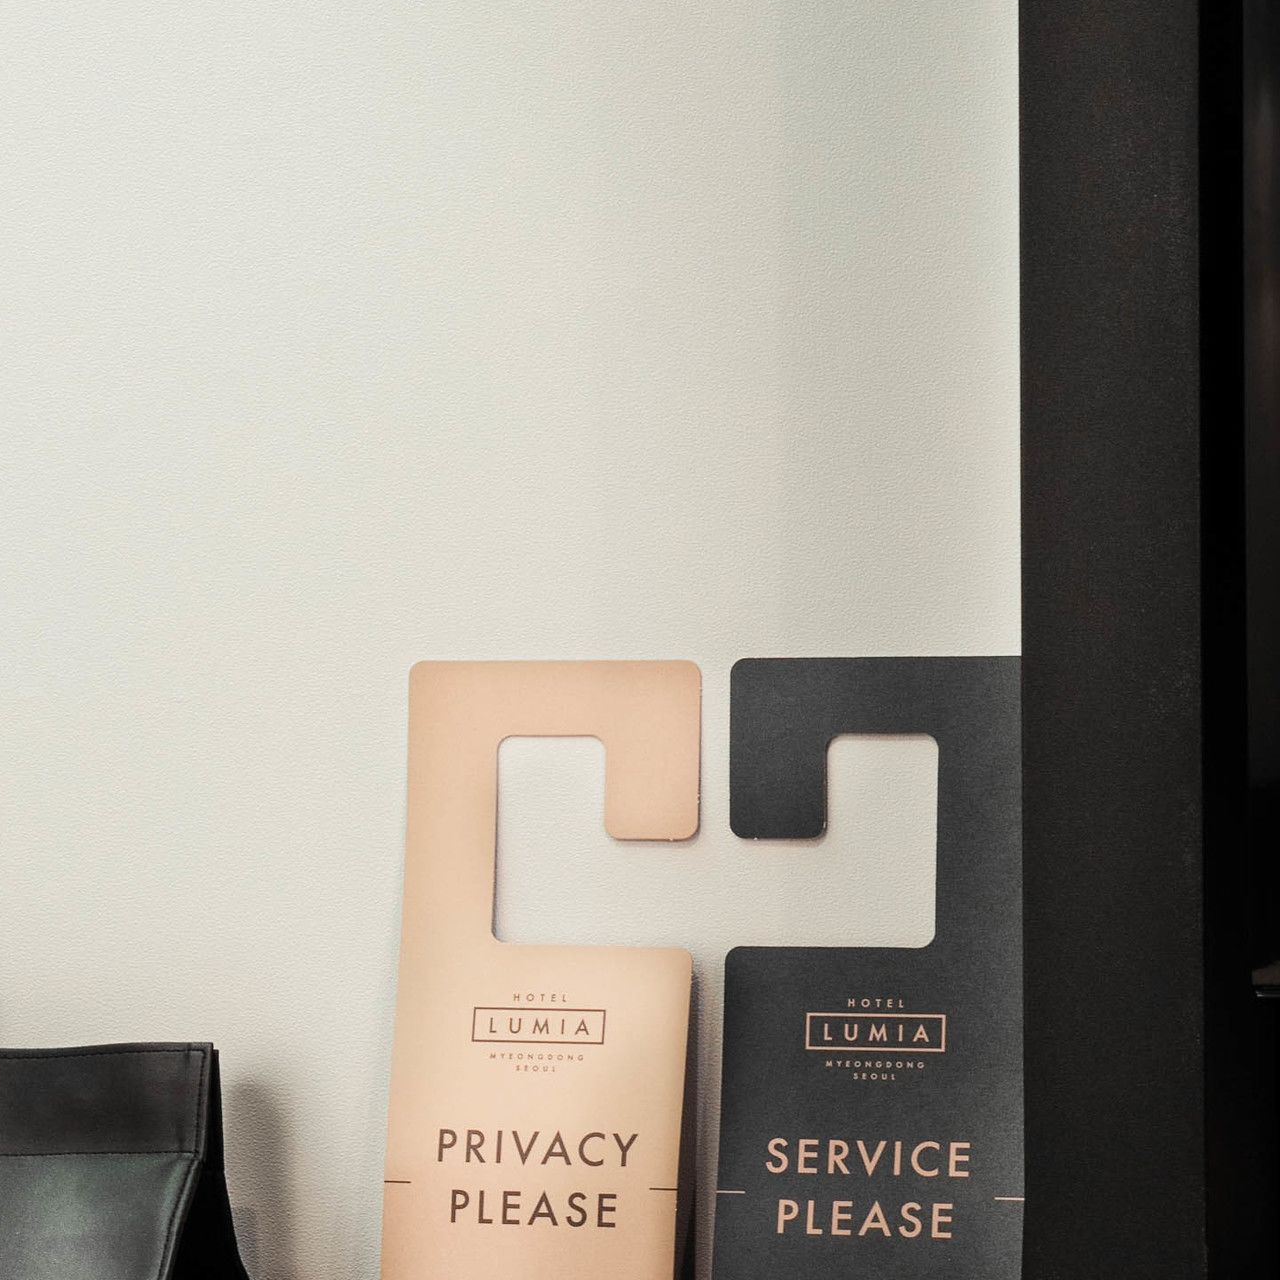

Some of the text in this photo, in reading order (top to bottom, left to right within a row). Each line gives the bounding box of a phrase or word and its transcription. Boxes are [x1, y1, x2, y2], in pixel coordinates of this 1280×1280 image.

[513, 993, 567, 1003] HOTEL
[847, 998, 904, 1008] HOTEL
[489, 1017, 589, 1035] LUMIA
[823, 1023, 930, 1042] LUMIA
[489, 1052, 584, 1061] MYEONGDONG
[516, 1065, 556, 1073] SEOUL
[825, 1060, 925, 1069] MYEONGDONG
[853, 1073, 896, 1081] SEOUL
[437, 1128, 639, 1167] PRIVACY
[765, 1137, 971, 1178] SERVICE
[450, 1189, 617, 1228] PLEASE
[777, 1198, 953, 1239] PLEASE
